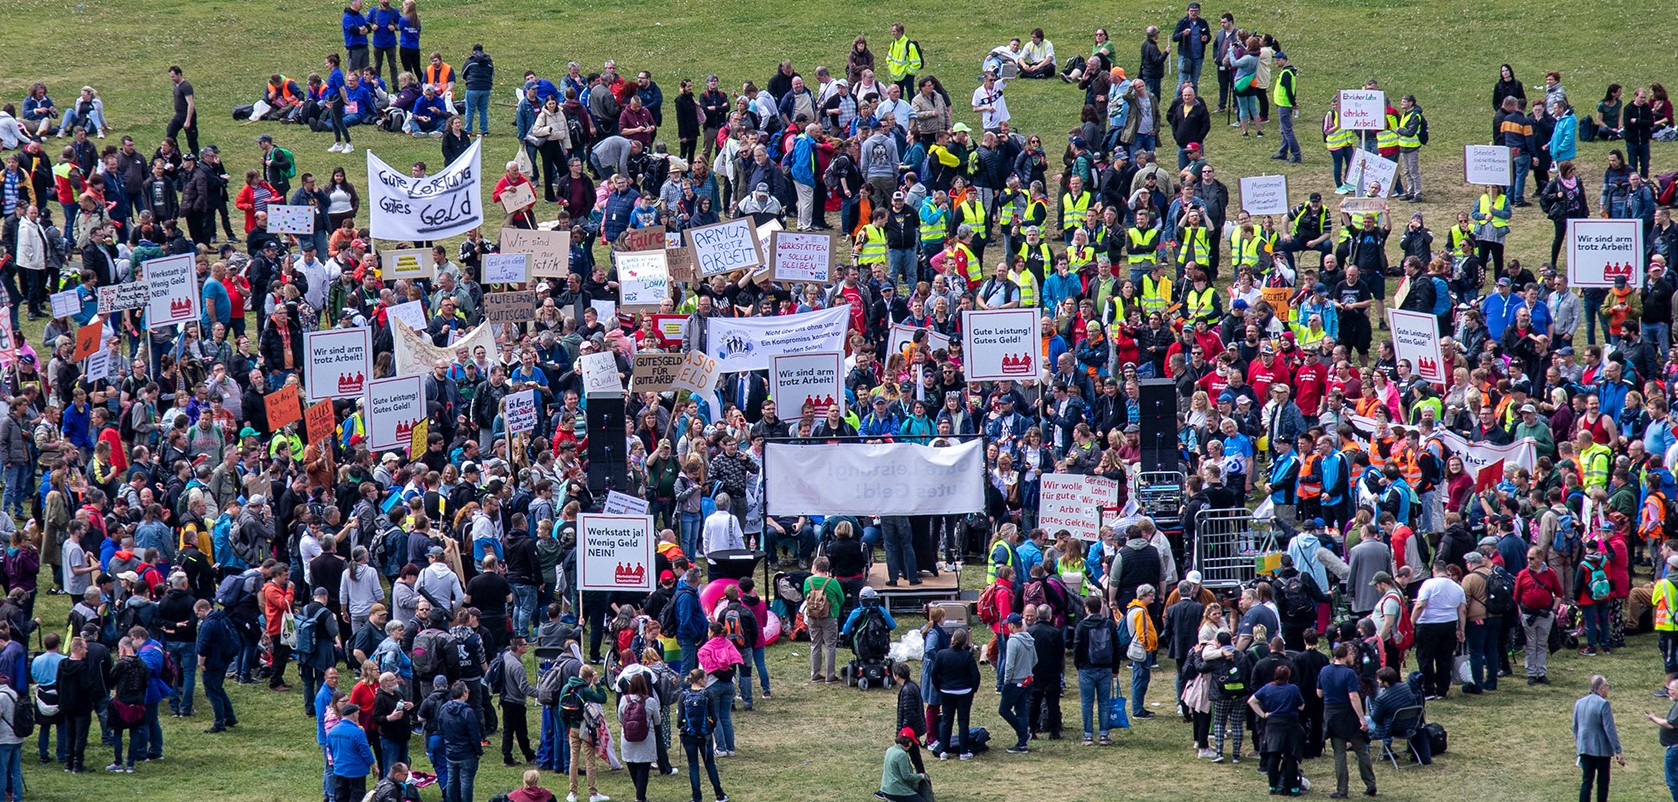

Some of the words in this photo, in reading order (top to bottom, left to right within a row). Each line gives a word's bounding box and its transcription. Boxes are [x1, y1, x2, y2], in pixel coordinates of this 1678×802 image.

[1353, 118, 1377, 127] Arbeit
[505, 232, 528, 248] Wir
[531, 236, 550, 247] sind
[629, 231, 665, 249] Faire
[695, 226, 749, 248] ARMUT
[1577, 234, 1592, 242] Wir
[1594, 234, 1613, 242] sind
[712, 240, 742, 252] TROTZ
[778, 241, 827, 251] WERKSTÄTTEN
[702, 247, 754, 272] ARBEIT
[788, 253, 814, 261] SOLLEN
[781, 261, 817, 270] BLEIBEN
[150, 268, 180, 279] Werkstatt
[150, 280, 169, 290] Wenig
[170, 276, 185, 286] Geld
[644, 280, 667, 290] LOHN
[151, 289, 169, 298] NEIN!
[994, 326, 1031, 336] Leistung!
[1397, 327, 1409, 335] Gute
[772, 336, 811, 345] Kompromiss
[999, 336, 1021, 344] Geld!
[1398, 336, 1412, 345] Gutes
[313, 348, 328, 356] Wir
[329, 345, 345, 354] sind
[313, 357, 333, 365] trotz
[335, 353, 363, 362] Arbeit!
[636, 356, 663, 367] GUTES
[663, 356, 682, 366] GELD
[685, 352, 715, 374] ASIS
[652, 366, 668, 375] FÜR
[779, 370, 793, 378] Wir
[796, 368, 814, 376] sind
[654, 375, 676, 384] ARBE
[679, 367, 708, 389] ELD
[779, 379, 800, 387] trotz
[802, 376, 834, 385] Arbeit!
[373, 397, 388, 405] Gute
[389, 391, 418, 403] Leistung!
[310, 401, 330, 421] ALLES
[373, 406, 392, 414] Gutes
[392, 401, 411, 411] Geld!
[1465, 451, 1487, 465] her
[1043, 480, 1059, 490] Wir
[1061, 482, 1082, 490] wolle
[1084, 476, 1117, 489] Gerechter
[1091, 486, 1107, 496] Lohn
[1042, 492, 1054, 500] für
[1056, 492, 1075, 501] gute
[1082, 495, 1094, 504] Wir
[1096, 498, 1108, 506] sind
[1059, 505, 1080, 513] Arbe
[1041, 516, 1062, 525] gutes
[1082, 519, 1095, 529] Kein
[587, 527, 631, 537] Werkstatt
[632, 528, 644, 539] ja!
[1082, 531, 1096, 539] vom
[587, 538, 615, 549] Wenig
[617, 539, 638, 548] Geld
[587, 548, 615, 557] NEIN!
